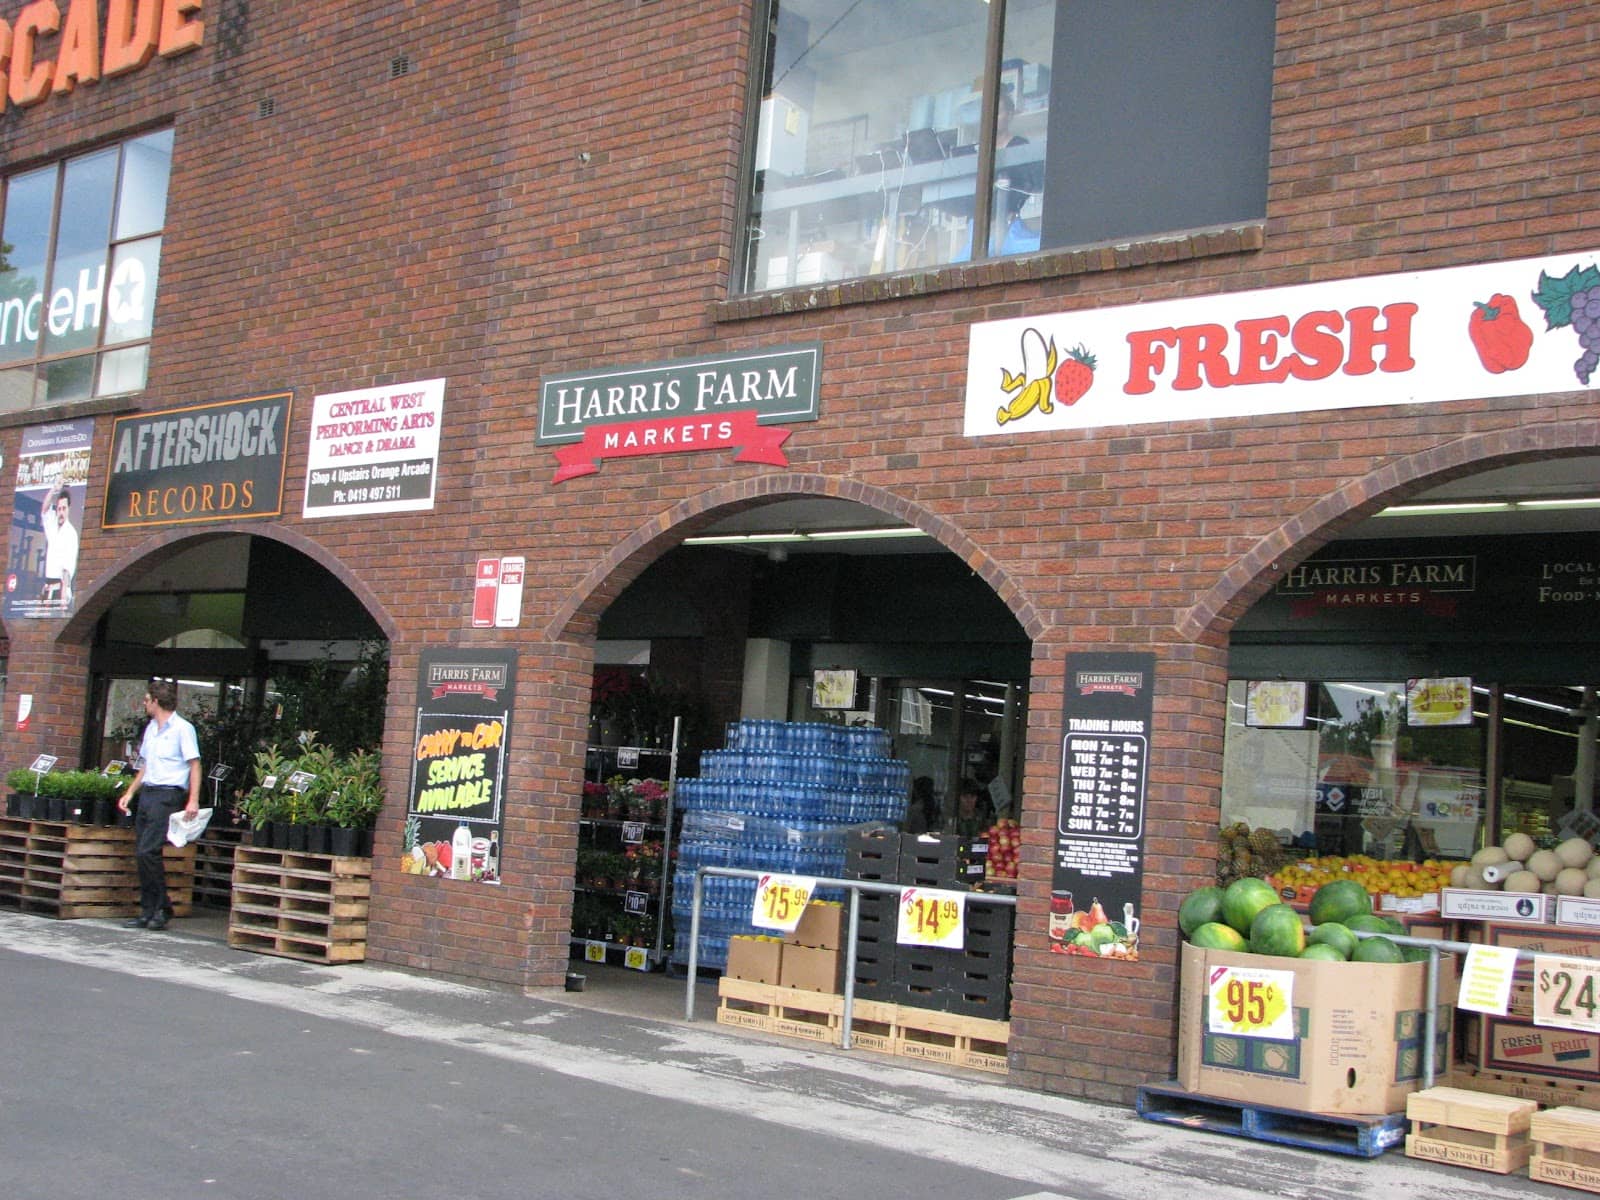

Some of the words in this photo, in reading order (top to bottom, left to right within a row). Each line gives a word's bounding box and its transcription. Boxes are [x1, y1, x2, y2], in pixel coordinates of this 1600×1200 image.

[1123, 302, 1419, 395] FRESH
[329, 397, 386, 418] CENTRAL
[389, 392, 426, 410] WEST
[554, 379, 681, 426] HARRIS
[694, 366, 798, 412] FARM
[316, 416, 398, 440] PERFORMING
[400, 411, 435, 430] ARTS
[114, 406, 281, 474] AFTERSHOCK
[604, 421, 733, 449] MARKETS
[328, 441, 363, 457] DANCE
[365, 440, 374, 453] &
[376, 436, 416, 452] DRAMA
[311, 471, 330, 486] Shop
[331, 470, 337, 483] 4
[338, 468, 370, 485] Upstairs
[371, 465, 401, 480] Orange
[401, 461, 431, 476] Arcade
[128, 480, 254, 518] RECORDS
[333, 490, 346, 503] Ph:
[347, 488, 368, 503] 0419
[369, 486, 385, 501] 497
[385, 485, 401, 500] 511
[1287, 564, 1382, 589] HARRIS
[1391, 562, 1466, 587] FARM
[1326, 592, 1422, 604] MARKETS
[1539, 586, 1585, 602] FOOD
[432, 667, 469, 681] HARRIS
[471, 667, 501, 682] FARM
[1080, 674, 1111, 684] HARRIS
[1113, 674, 1138, 684] FARM
[1069, 718, 1110, 732] TRADING
[1111, 719, 1144, 733] HOURS
[1071, 739, 1098, 752] MON
[1075, 752, 1097, 764] TUE
[428, 752, 487, 786] SERVICE
[1070, 765, 1096, 778] WED
[1072, 778, 1095, 791] THU
[417, 778, 493, 813] AVAILABLE
[1074, 792, 1093, 804] FRI
[1071, 805, 1093, 817] SAT
[1068, 818, 1092, 830] SUN
[762, 886, 809, 921] $15.99
[906, 898, 959, 934] $14.99
[1501, 1034, 1544, 1050] FRESH
[1551, 1037, 1590, 1052] FRUIT
[1419, 1143, 1448, 1158] FARM
[1450, 1151, 1489, 1165] HARRIS
[1545, 1167, 1578, 1182] FARM
